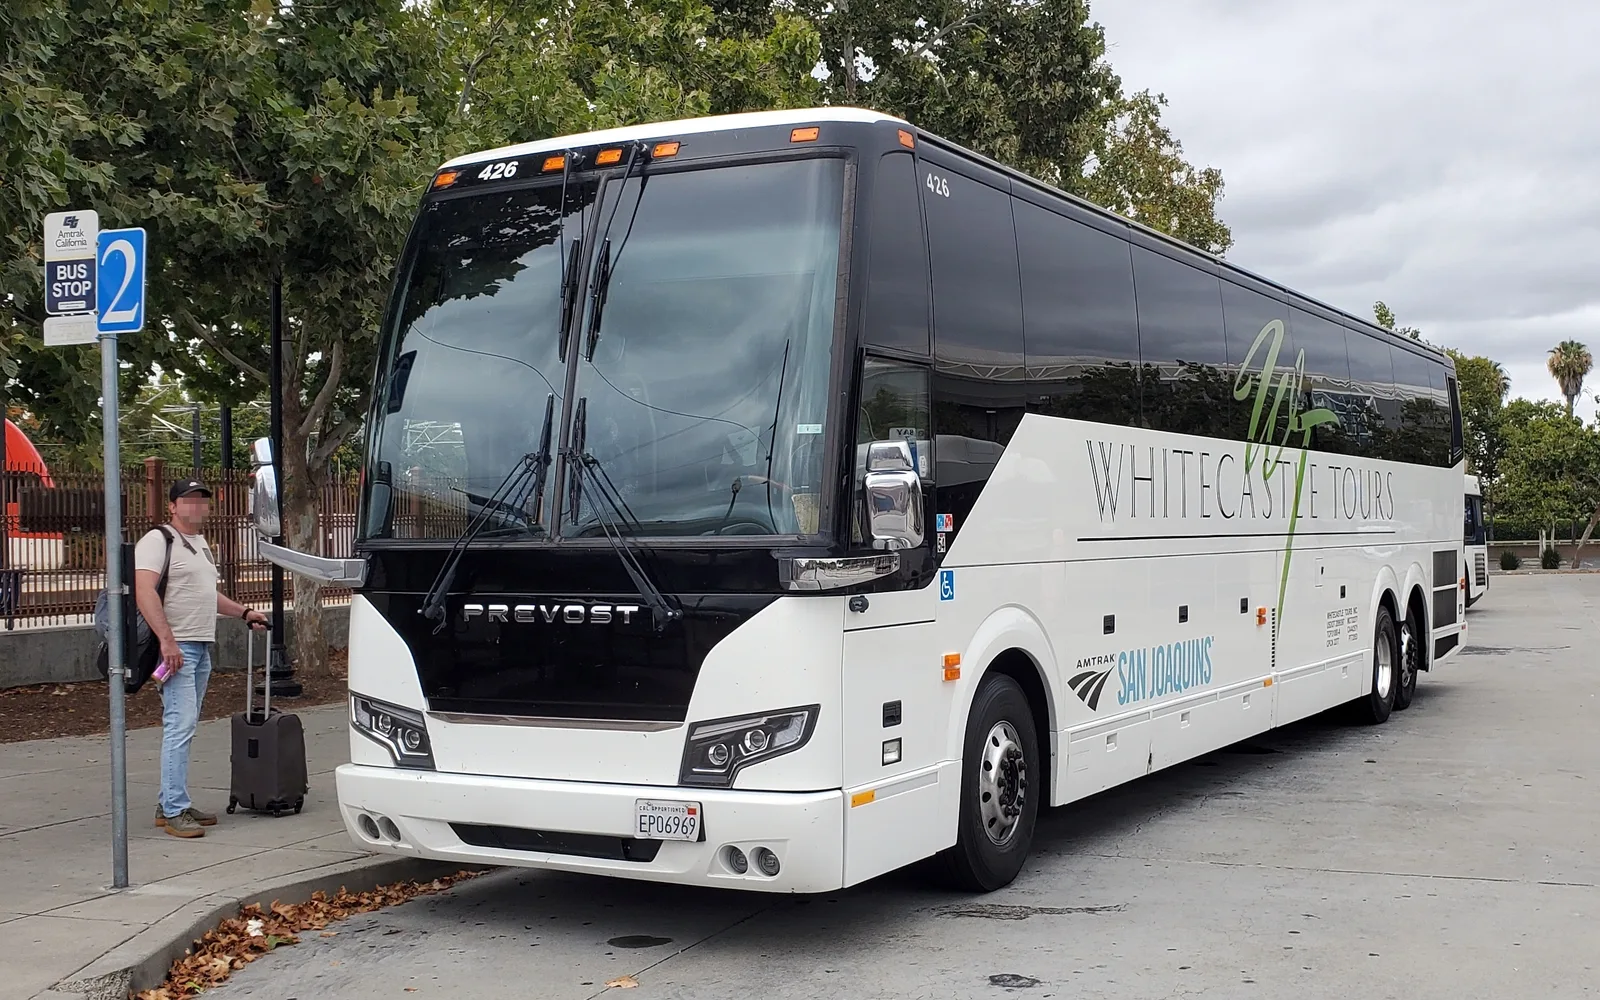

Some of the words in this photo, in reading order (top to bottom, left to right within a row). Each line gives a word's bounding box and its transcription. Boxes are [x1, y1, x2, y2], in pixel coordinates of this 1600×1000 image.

[478, 161, 519, 181] 426
[926, 173, 950, 197] 426
[55, 238, 87, 248] California
[57, 229, 85, 238] Amtrak
[56, 263, 87, 281] BUS
[100, 239, 139, 324] 2
[52, 280, 92, 298] STOP
[1085, 440, 1319, 523] WHITECASTLE
[1328, 466, 1396, 521] TOURS
[463, 604, 639, 624] PREVOST
[1076, 654, 1115, 669] AMTRAK
[1117, 648, 1147, 706] SAN
[1149, 636, 1213, 700] JOAQUINS
[639, 814, 696, 835] EP06969
